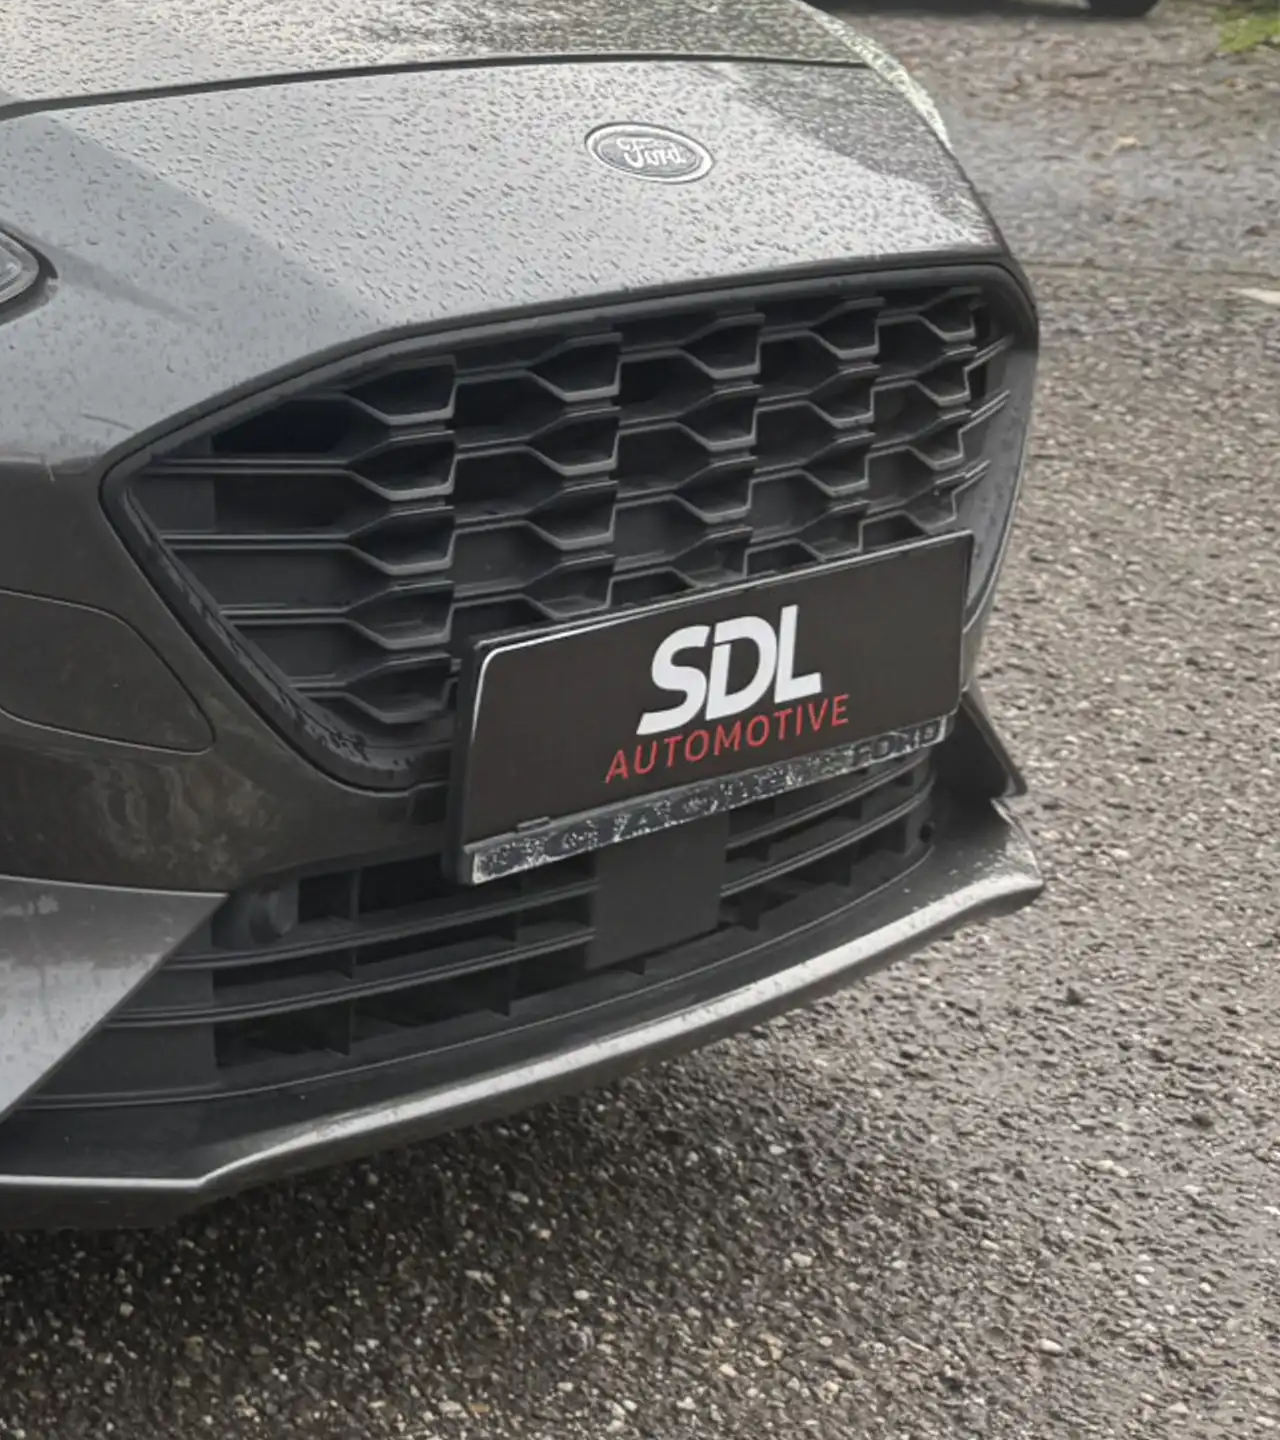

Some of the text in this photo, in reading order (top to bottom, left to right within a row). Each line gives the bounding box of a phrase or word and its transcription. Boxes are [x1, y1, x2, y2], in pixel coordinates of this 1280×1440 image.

[616, 137, 687, 168] Ford
[636, 605, 821, 734] SDL
[605, 694, 849, 783] AUTOMOTIVE
